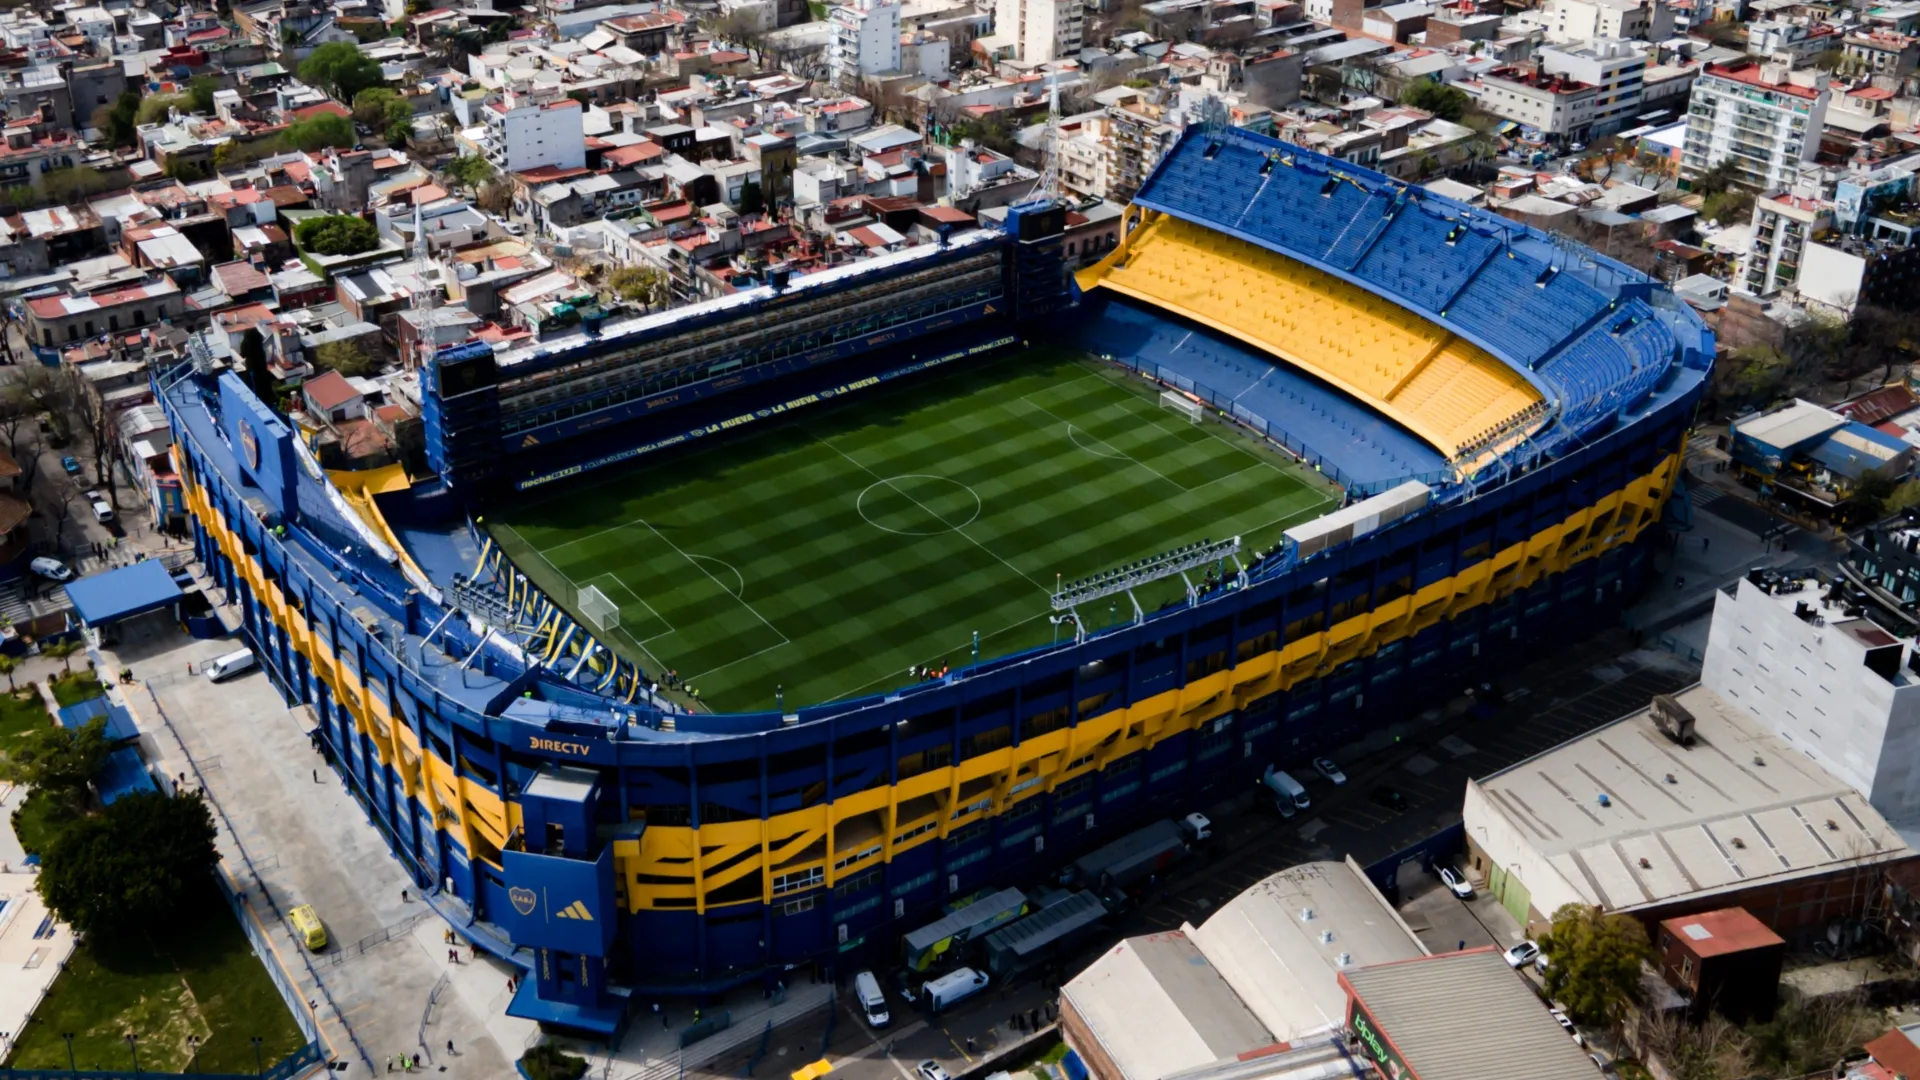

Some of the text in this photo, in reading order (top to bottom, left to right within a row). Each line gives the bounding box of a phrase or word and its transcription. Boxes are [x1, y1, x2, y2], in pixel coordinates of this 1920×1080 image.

[834, 375, 880, 395] LA NUEVA
[771, 394, 820, 414] LA NUEVA
[705, 413, 756, 434] LA NUEVA
[637, 443, 657, 454] BOCA
[529, 736, 590, 756] DIRECTV
